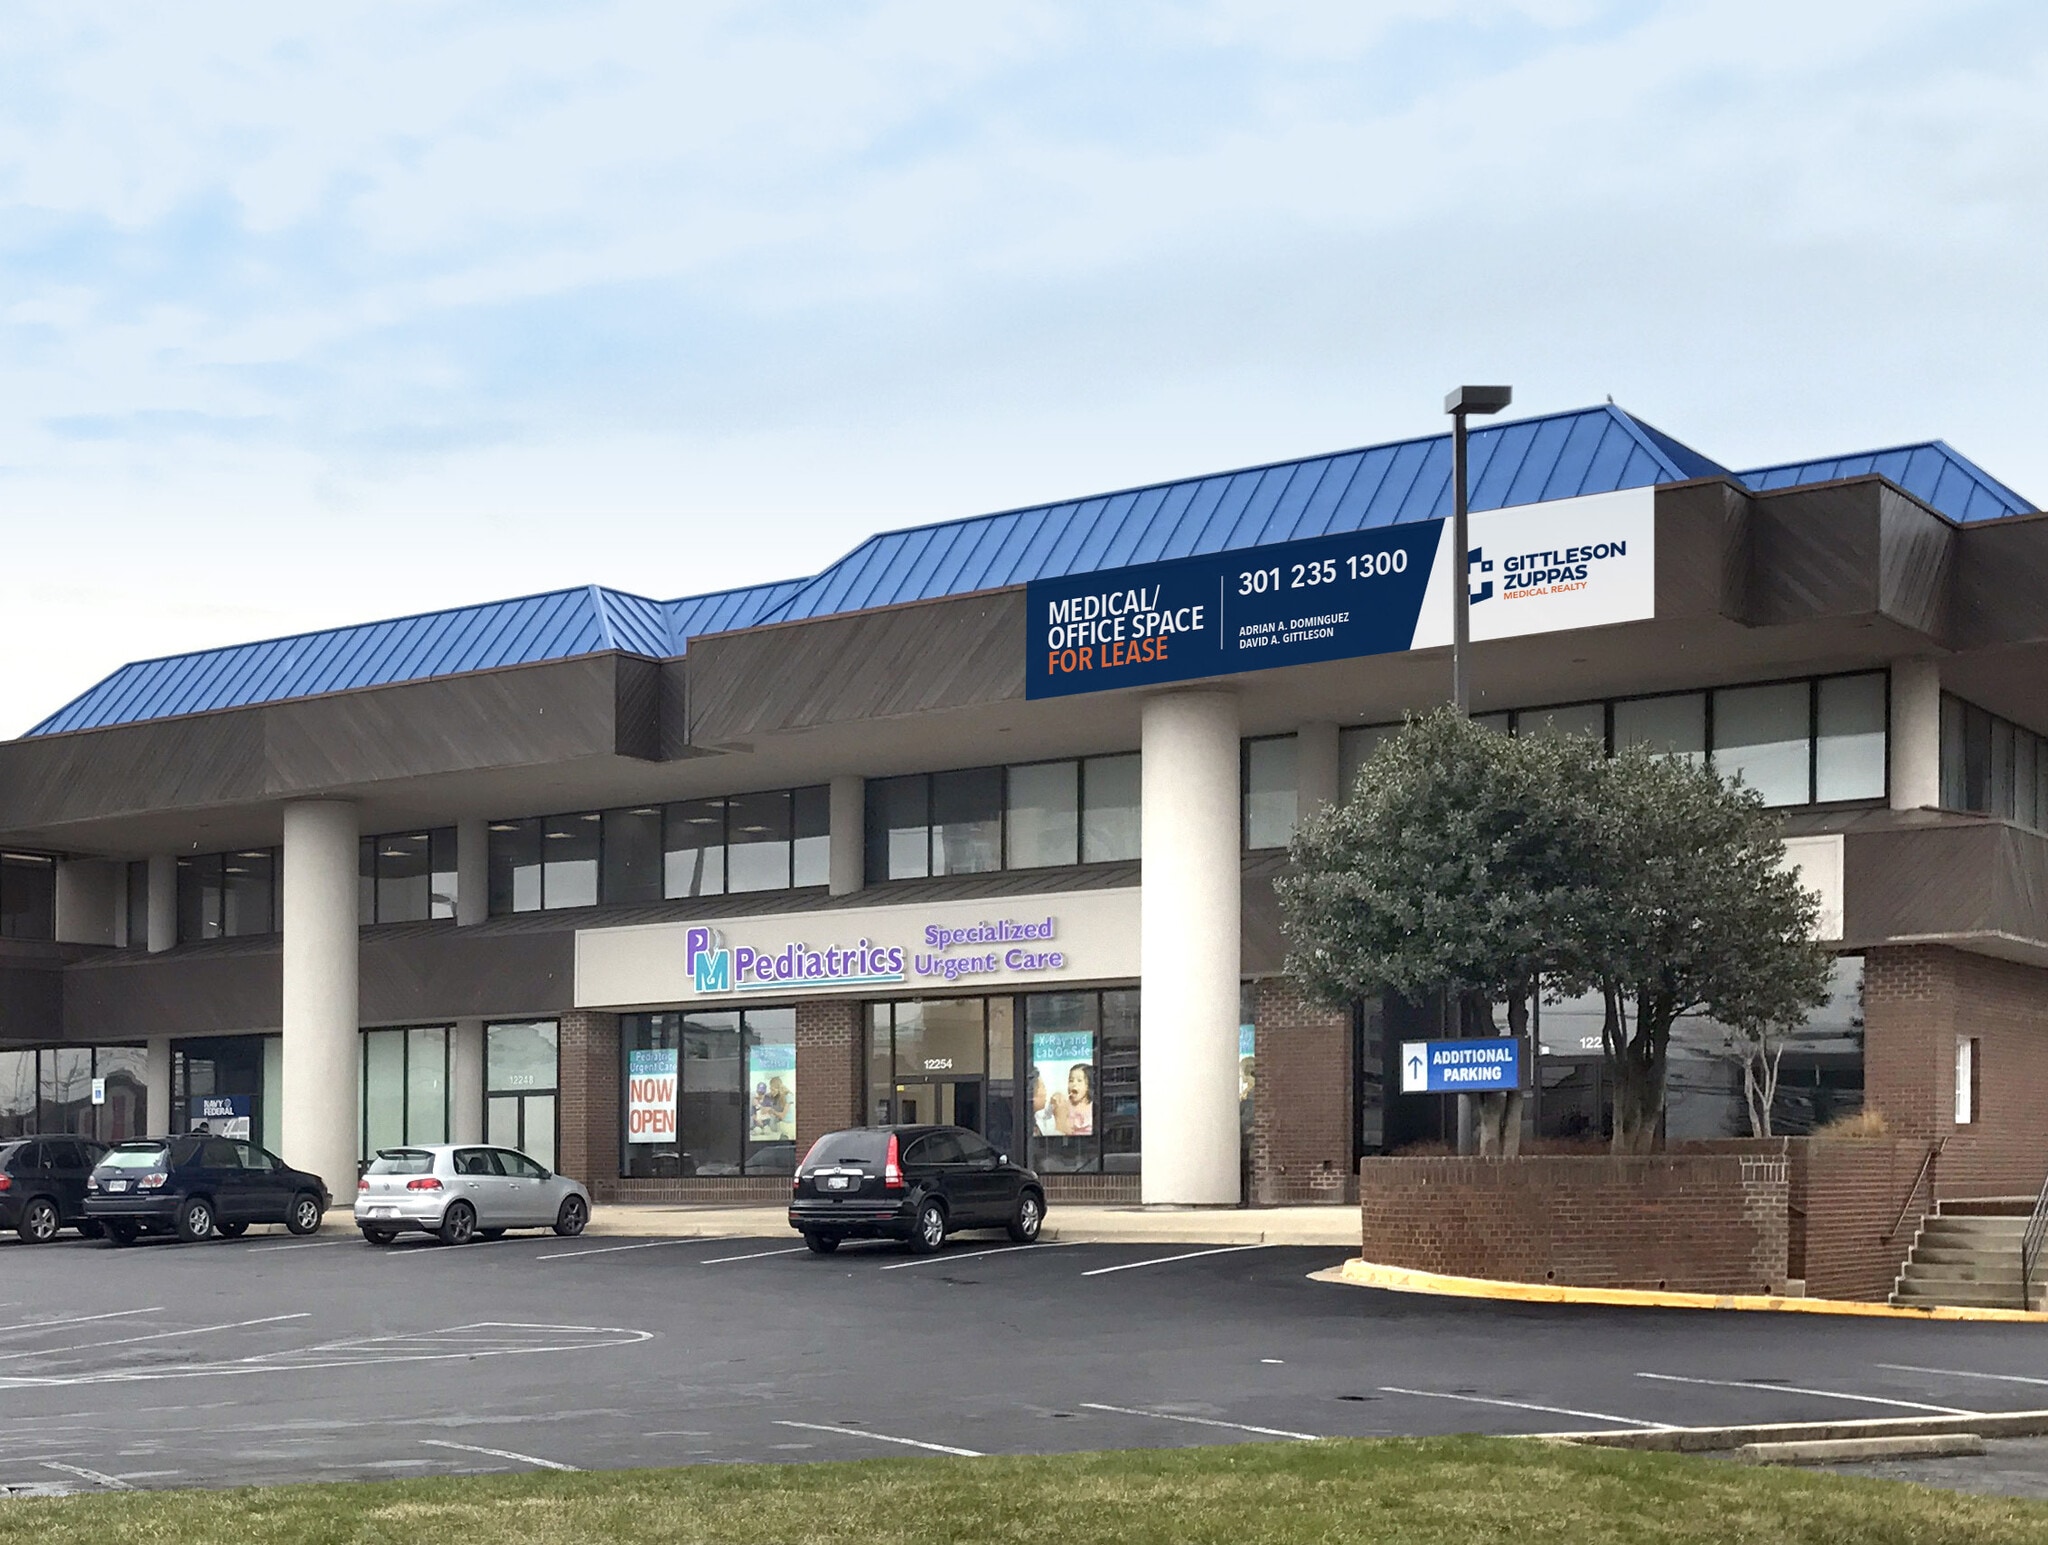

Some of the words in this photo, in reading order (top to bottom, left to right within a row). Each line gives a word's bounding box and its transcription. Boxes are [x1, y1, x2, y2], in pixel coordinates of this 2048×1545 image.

[1504, 541, 1626, 572] GITTLESON
[1238, 567, 1280, 596] 301
[1291, 559, 1337, 589] 235
[1346, 549, 1408, 580] 1300
[1503, 565, 1588, 590] ZUPPAS
[1503, 588, 1549, 600] MEDICAL
[1551, 582, 1588, 594] REALTY
[1049, 584, 1161, 624] MEDICAL/
[1048, 617, 1125, 650] OFFICE
[1131, 605, 1204, 638] SPACE
[1239, 622, 1275, 637] ADRIAN
[1278, 621, 1288, 631] A.
[1290, 612, 1349, 629] DOMINGUEZ
[1239, 637, 1268, 649] DAVID
[1270, 634, 1280, 645] A.
[1282, 627, 1334, 643] GITTLESON
[1048, 646, 1093, 675] FOR
[1101, 635, 1168, 668] LEASE
[925, 916, 1053, 950] Specialized
[735, 937, 905, 982] Pediatrics
[914, 953, 996, 980] Urgent
[1004, 948, 1064, 970] Care
[1069, 1034, 1088, 1045] and
[924, 1059, 953, 1070] 12254
[1036, 1048, 1054, 1058] Lab
[1433, 1048, 1513, 1065] ADDITIONAL
[510, 1075, 534, 1085] 12248
[1443, 1066, 1502, 1082] PARKING
[631, 1079, 675, 1104] NOW
[203, 1107, 235, 1116] FEDERAL
[630, 1109, 675, 1134] OPEN
